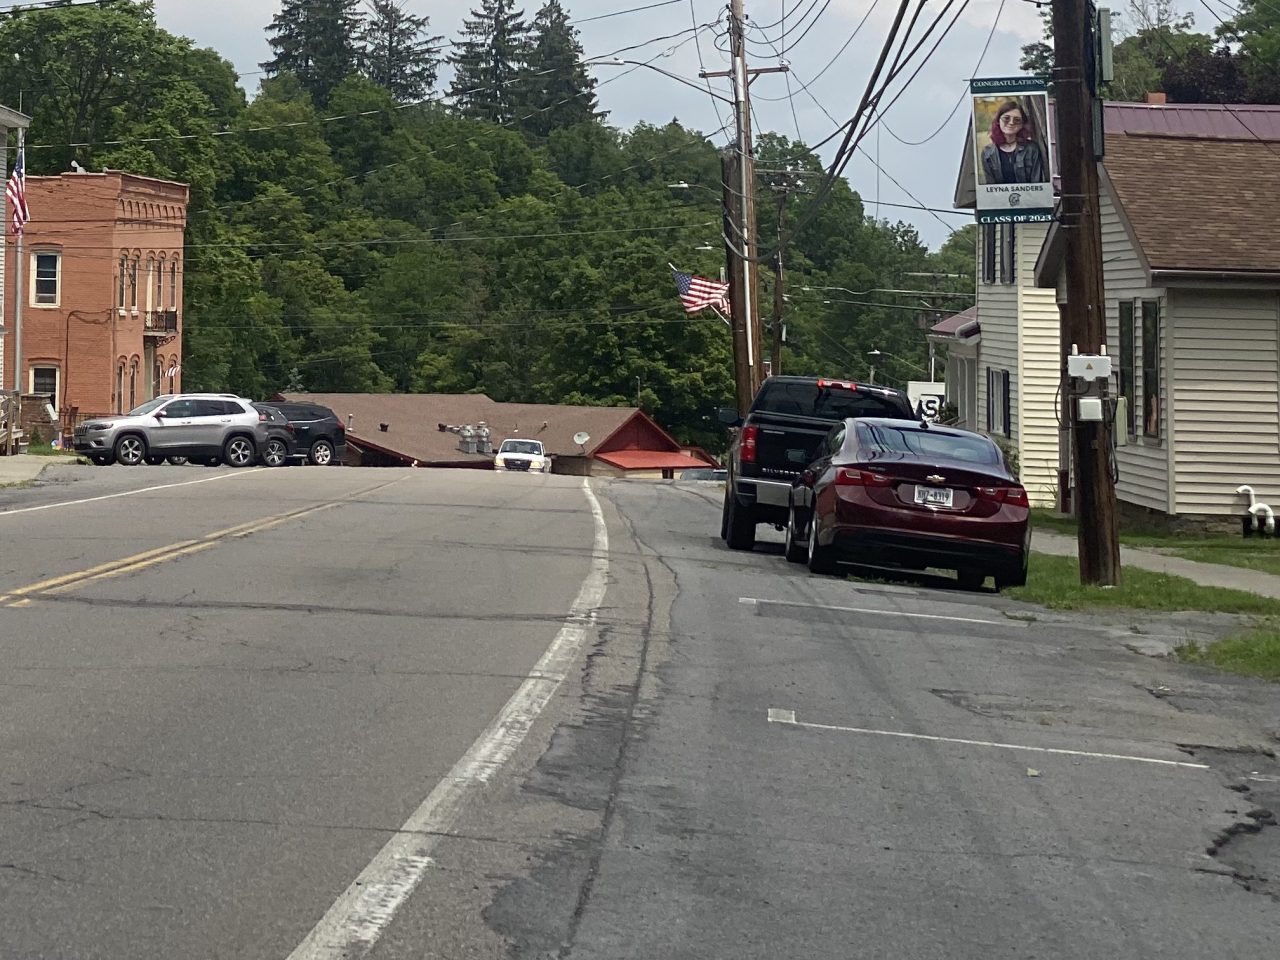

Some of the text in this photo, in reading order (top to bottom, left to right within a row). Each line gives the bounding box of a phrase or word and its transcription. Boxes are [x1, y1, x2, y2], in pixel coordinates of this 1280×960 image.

[972, 79, 1045, 87] CONGRATULATIONS
[980, 215, 1012, 224] CLASS
[1028, 214, 1052, 222] 2023
